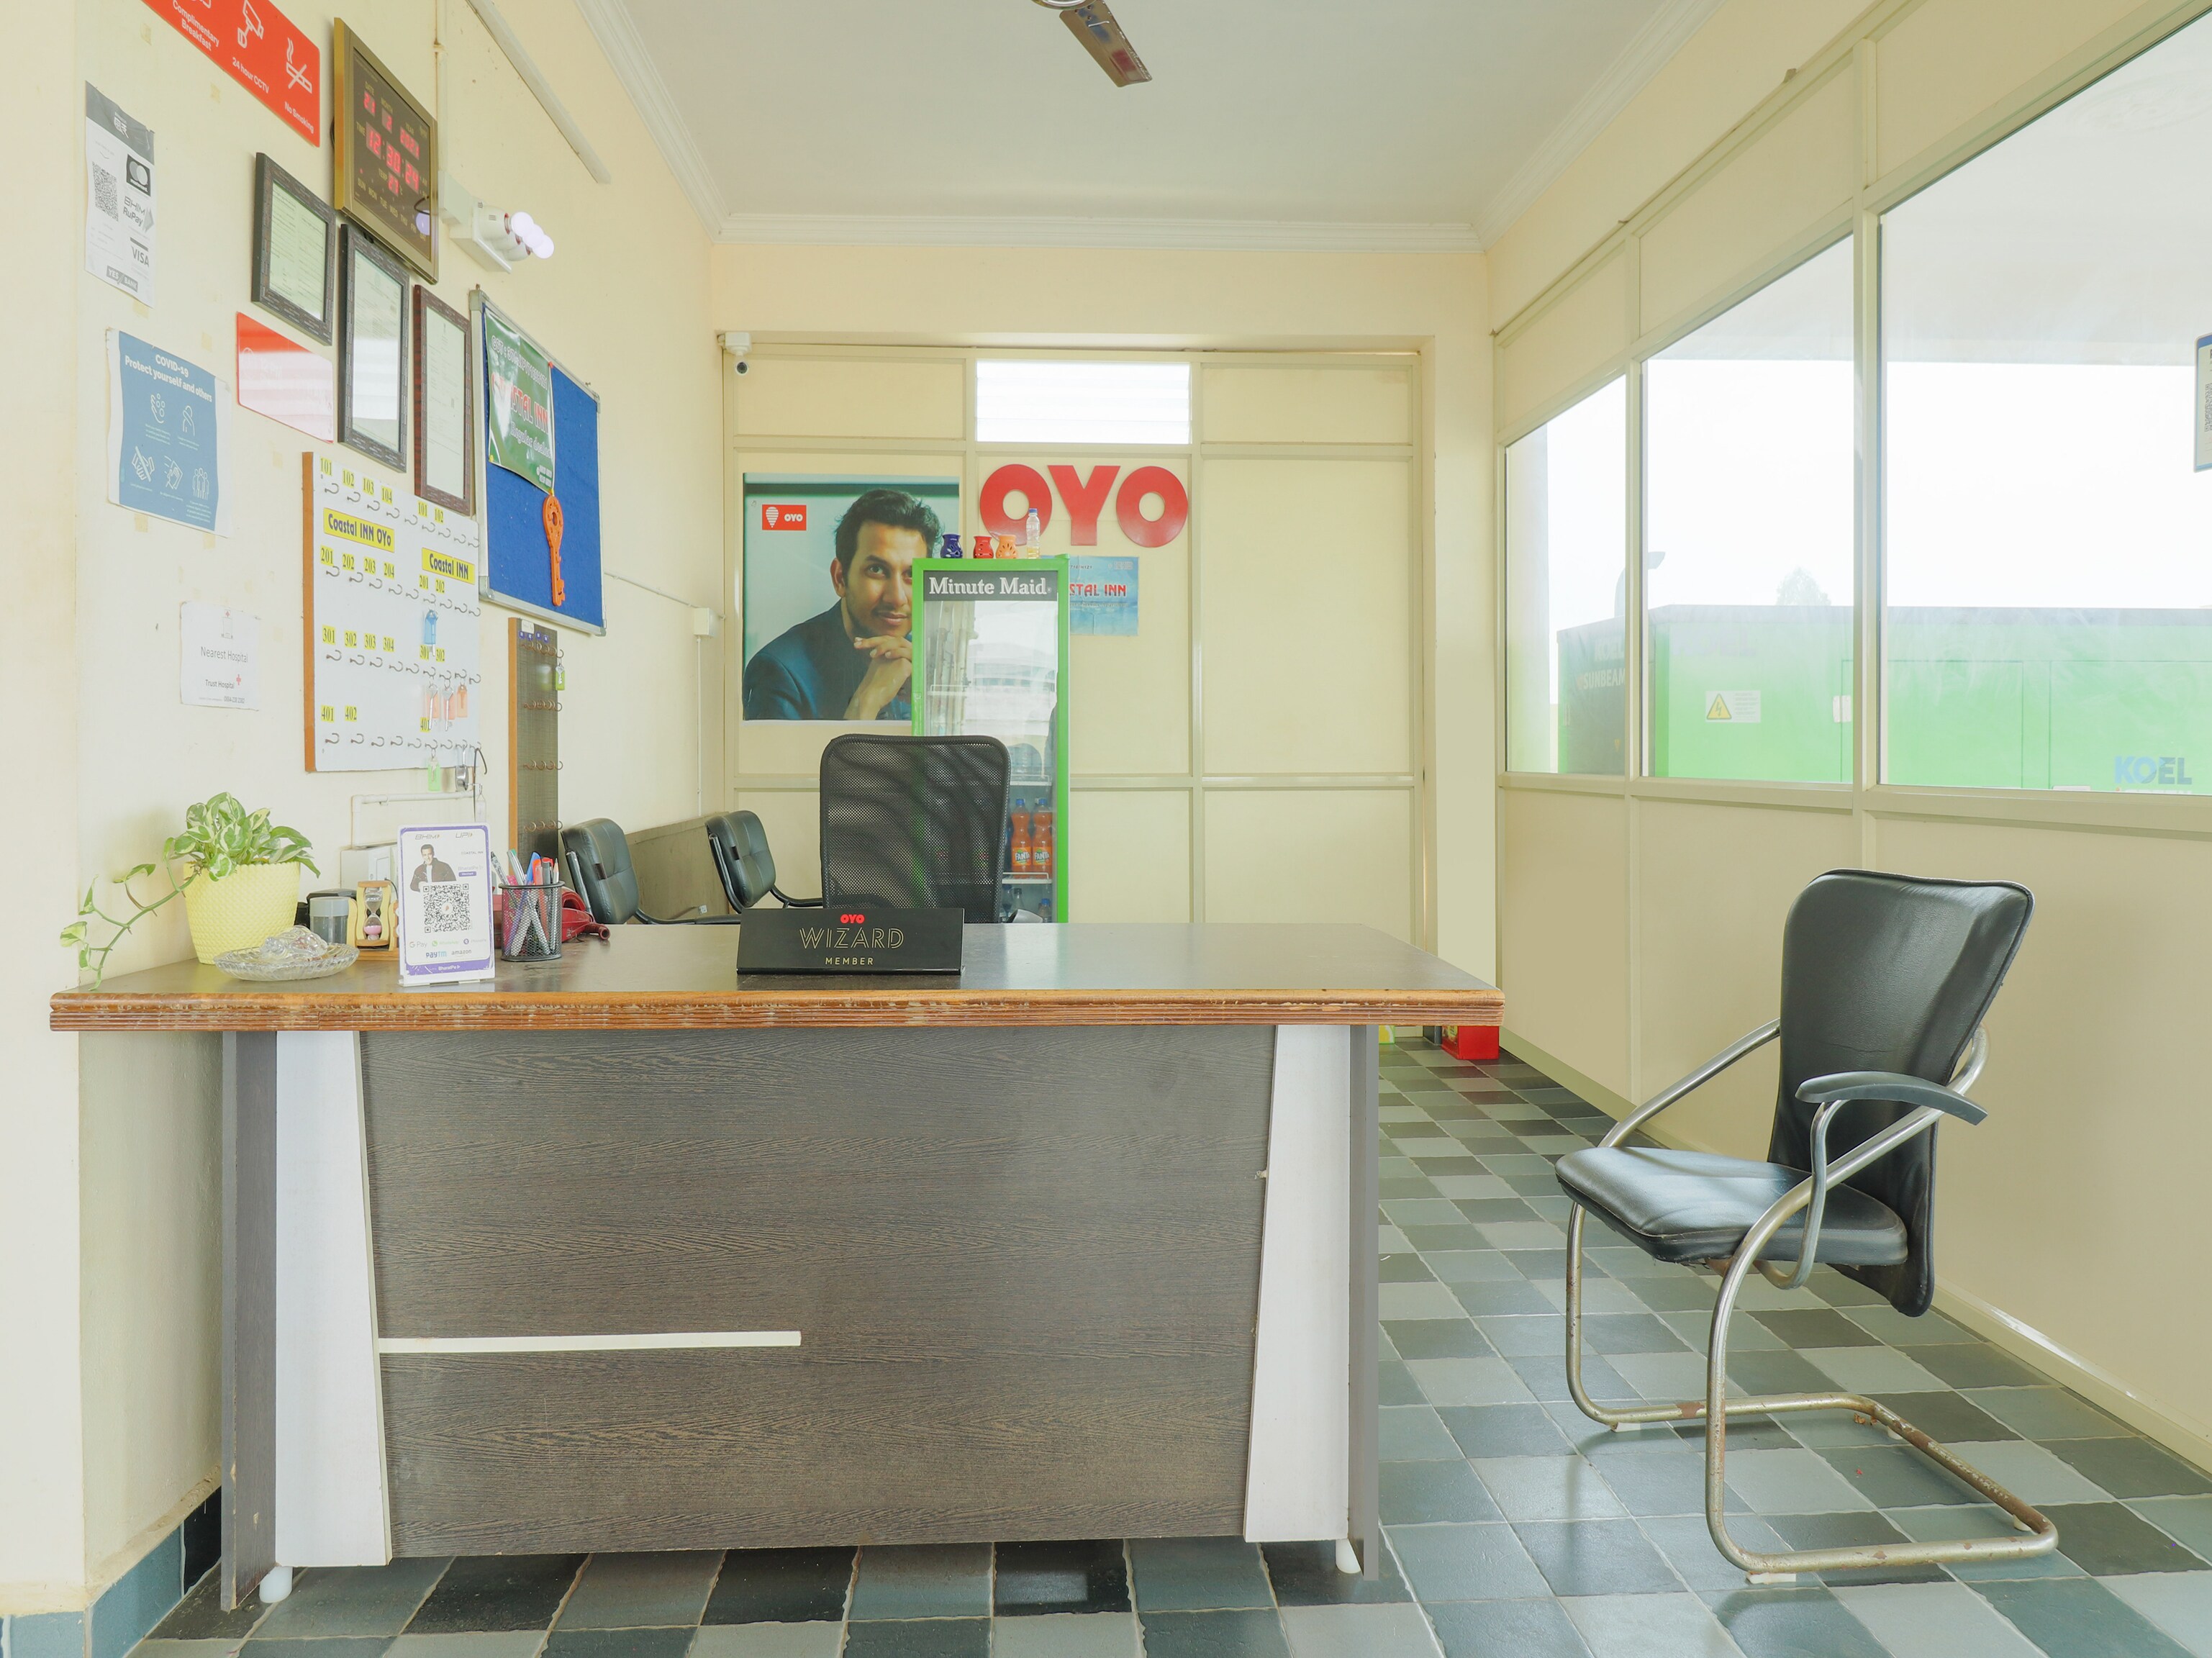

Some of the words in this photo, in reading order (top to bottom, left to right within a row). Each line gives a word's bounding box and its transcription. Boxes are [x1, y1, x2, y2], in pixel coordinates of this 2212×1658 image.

[173, 0, 219, 47] Complimentary
[181, 18, 212, 51] Breakfast
[232, 57, 240, 70] 24
[240, 65, 253, 81] hour
[253, 76, 270, 94] CCTV
[284, 101, 292, 114] No
[292, 109, 314, 134] Smoking
[124, 196, 145, 215] BHIM
[123, 207, 143, 227] RuPay
[131, 245, 150, 267] VISA
[108, 268, 119, 281] YES
[123, 276, 138, 291] BANK
[155, 353, 189, 379] COVID-19
[124, 355, 153, 376] Protect
[152, 366, 183, 389] yourself
[182, 377, 196, 395] and
[195, 382, 213, 403] others
[321, 458, 332, 476] 101
[343, 470, 354, 487] 102
[363, 479, 374, 495] 103
[381, 487, 393, 504] 104
[418, 502, 427, 517] 101
[435, 508, 444, 523] 102
[980, 463, 1189, 548] OYO
[328, 513, 357, 537] Coastal
[360, 525, 373, 542] INN
[784, 513, 803, 522] OYO
[321, 548, 334, 565] 201
[342, 554, 355, 570] 202
[364, 558, 376, 574] 203
[384, 563, 394, 578] 204
[429, 553, 454, 576] Coastal
[456, 562, 468, 580] INN
[419, 576, 429, 590] 201
[435, 579, 445, 594] 202
[929, 576, 995, 595] Minute
[1000, 576, 1048, 595] Maid
[1069, 583, 1100, 597] STAL
[1104, 584, 1127, 597] INN
[322, 627, 335, 644] 301
[345, 632, 357, 648] 302
[364, 635, 376, 649] 303
[383, 638, 394, 652] 304
[201, 646, 226, 660] Nearest
[227, 650, 248, 664] Hospital
[435, 650, 445, 662] 302
[205, 679, 217, 688] Trust
[218, 681, 235, 690] Hospital
[1583, 668, 1626, 690] SUNBEAM
[321, 705, 334, 722] 401
[345, 706, 357, 721] 402
[2114, 755, 2193, 784] KOEL
[840, 914, 865, 924] OYO
[799, 927, 905, 949] WIZARD
[825, 956, 874, 966] MEMBER
